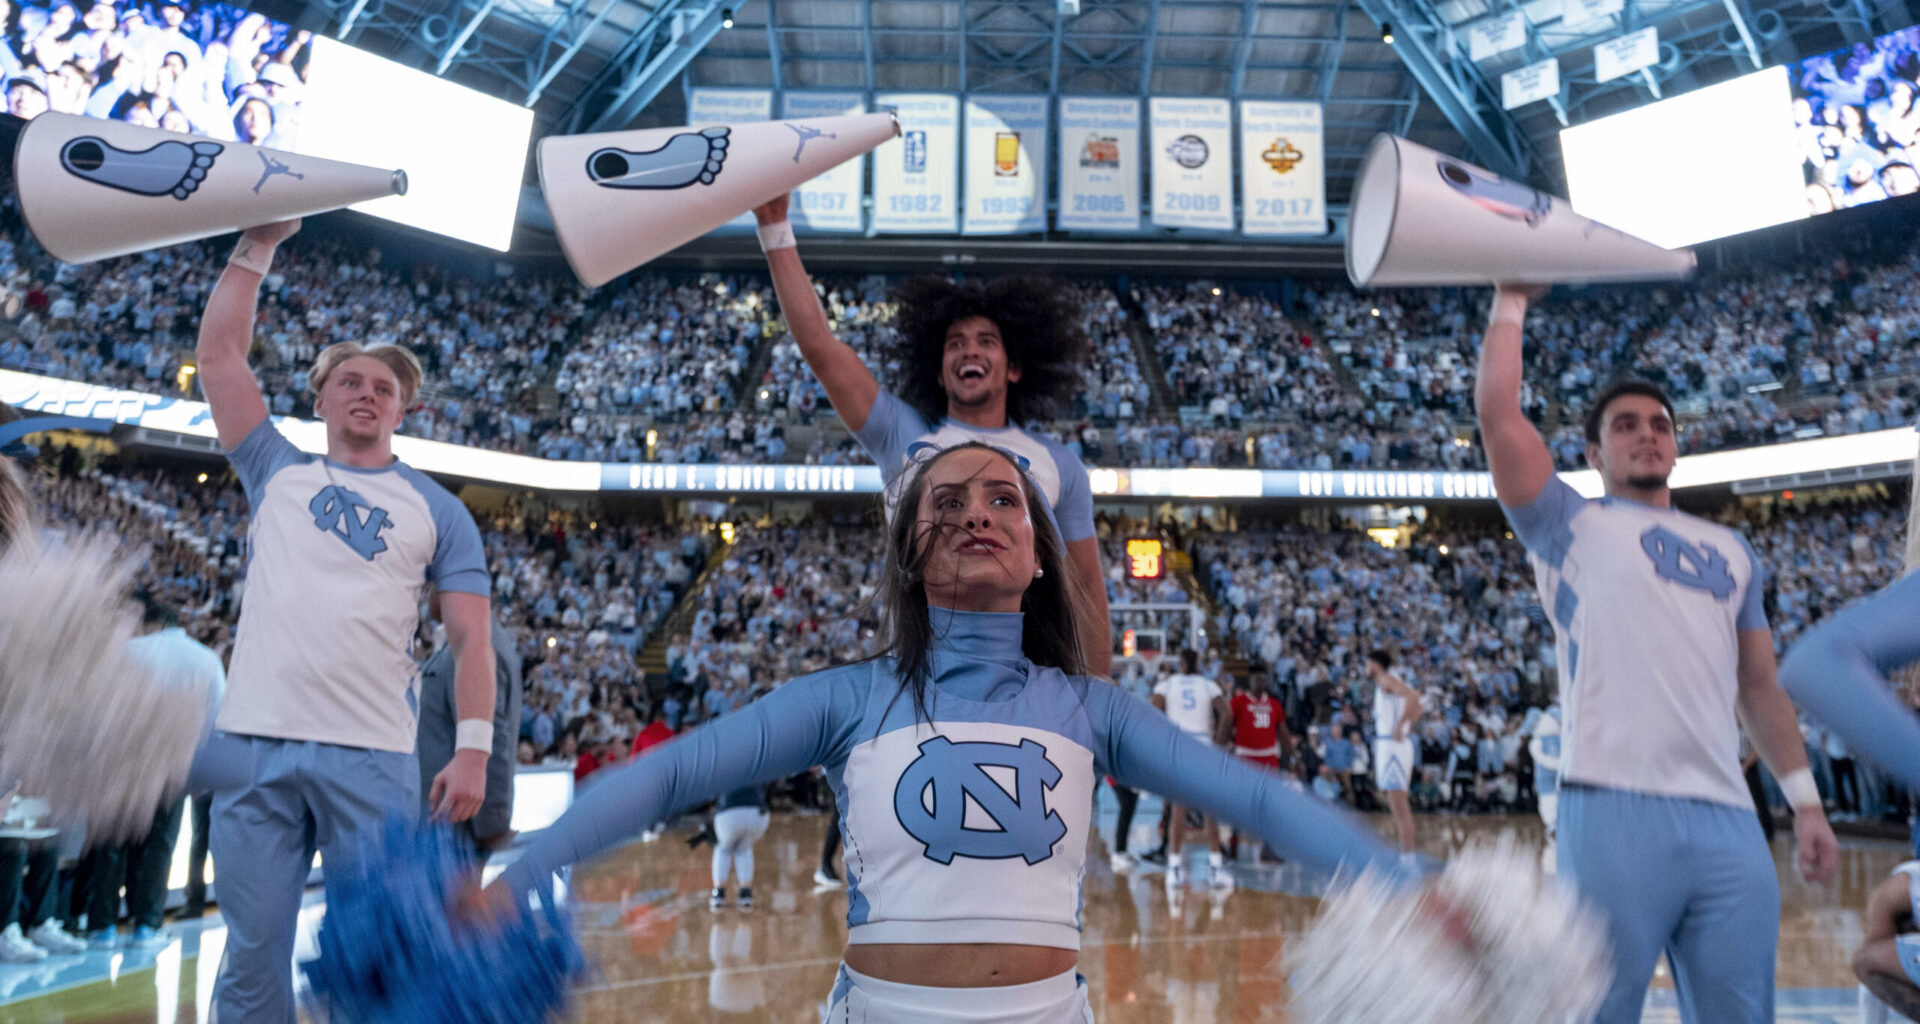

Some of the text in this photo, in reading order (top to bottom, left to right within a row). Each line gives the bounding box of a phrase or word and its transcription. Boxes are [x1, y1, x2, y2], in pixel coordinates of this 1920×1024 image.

[792, 191, 848, 211] 1957
[889, 194, 942, 213] 1982
[980, 196, 1032, 214] 1993
[1074, 194, 1126, 212] 2005
[1164, 191, 1221, 212] 2009
[1255, 198, 1313, 217] 2017
[629, 464, 678, 490] DEAN
[715, 465, 776, 491] SMITH
[784, 466, 855, 492] CENTER
[1342, 472, 1435, 498] WILLIAMS
[1182, 689, 1196, 710] 5
